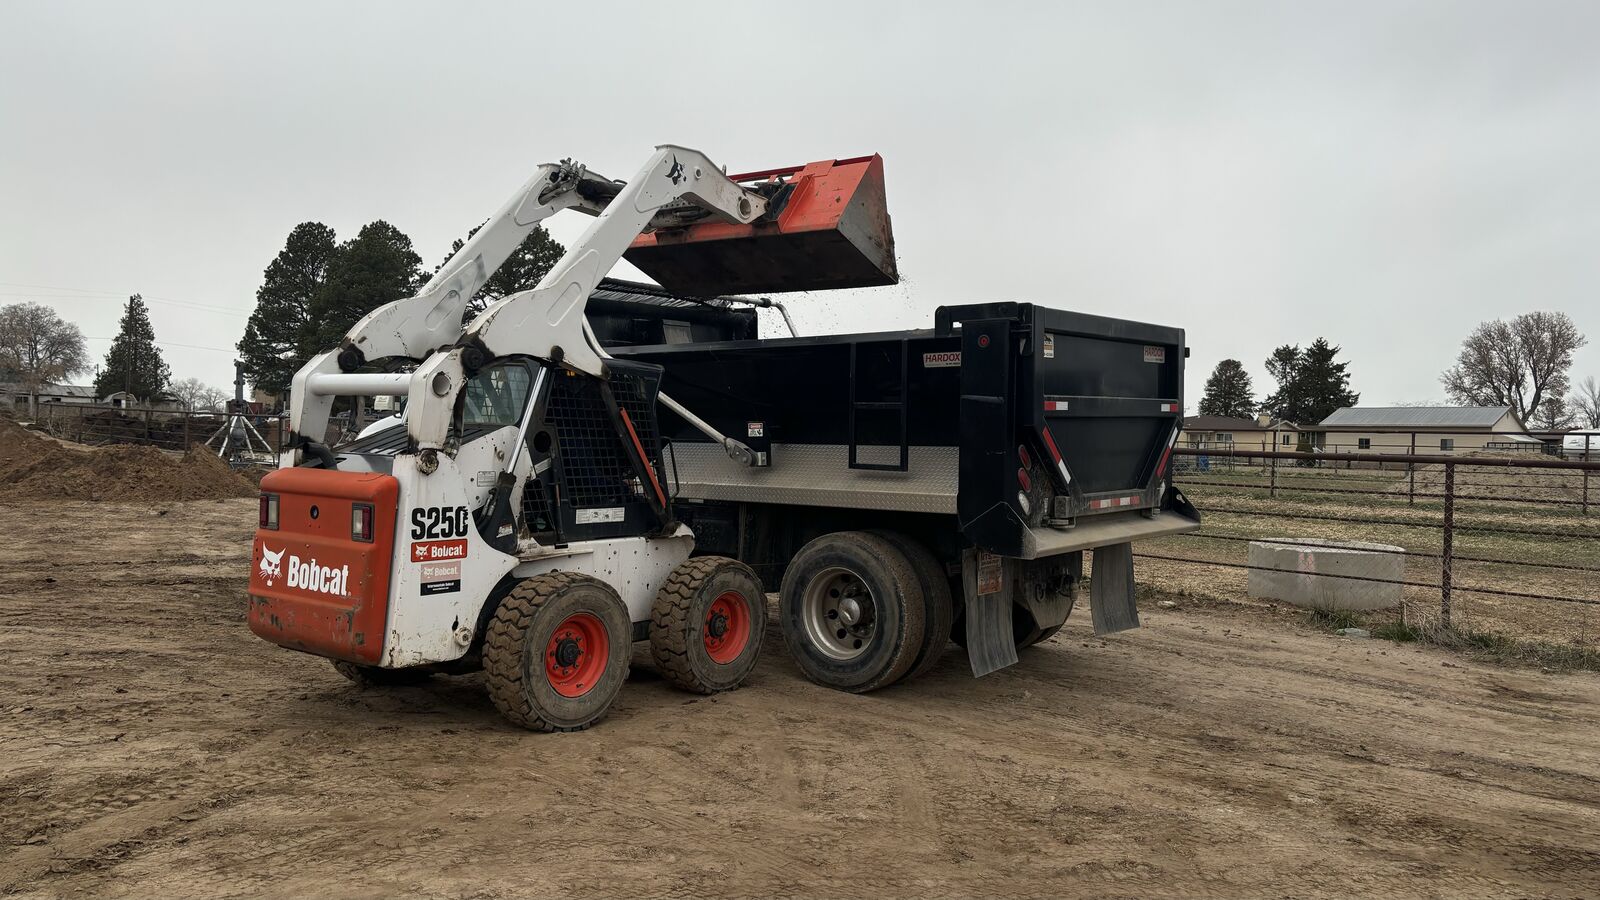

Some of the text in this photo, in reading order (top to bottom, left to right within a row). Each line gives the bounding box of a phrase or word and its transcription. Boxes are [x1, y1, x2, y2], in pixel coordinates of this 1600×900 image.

[925, 353, 960, 363] HARDOX
[411, 506, 468, 540] S250
[431, 544, 463, 558] Bobcat
[287, 555, 349, 597] Bobcat
[434, 566, 458, 577] Bobcat
